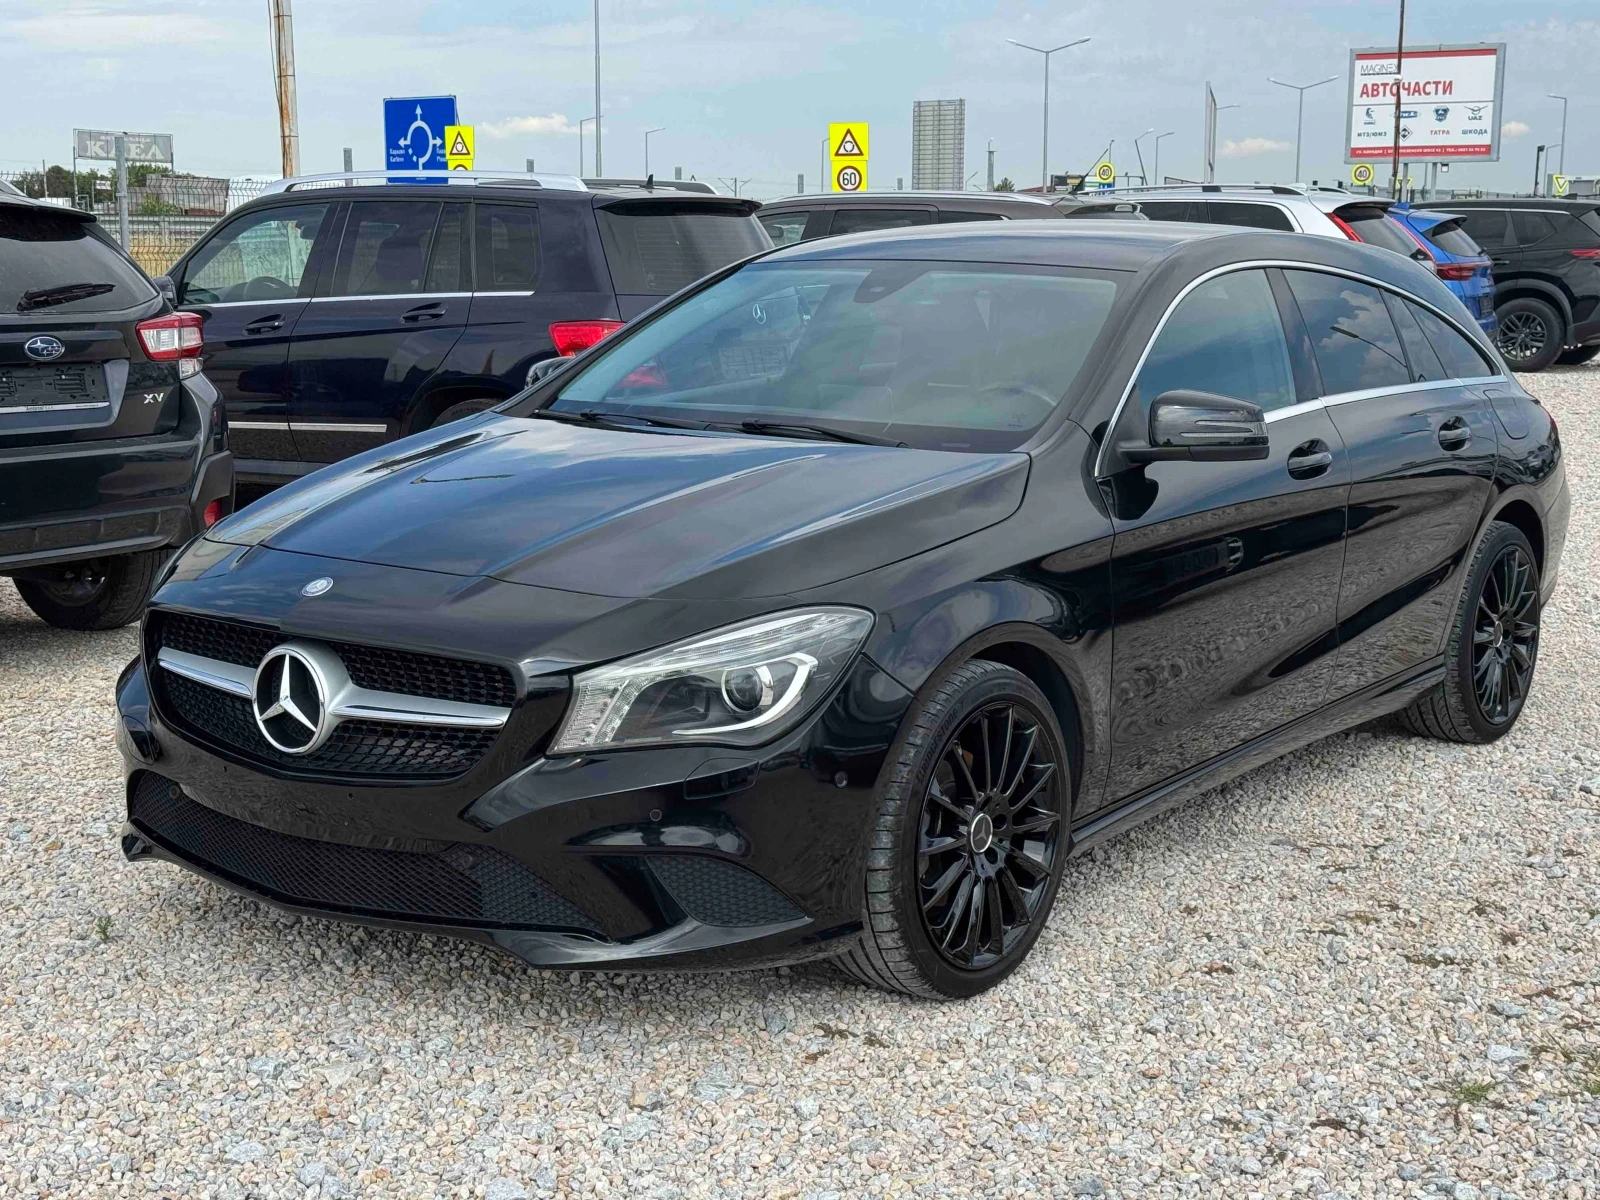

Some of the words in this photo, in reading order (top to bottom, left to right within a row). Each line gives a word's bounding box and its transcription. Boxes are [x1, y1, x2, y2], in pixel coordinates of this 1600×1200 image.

[1360, 81, 1453, 98] АВТОЧАСТИ
[1101, 168, 1110, 177] 40
[1358, 170, 1368, 178] 40
[842, 172, 857, 186] 60
[144, 392, 164, 404] XV
